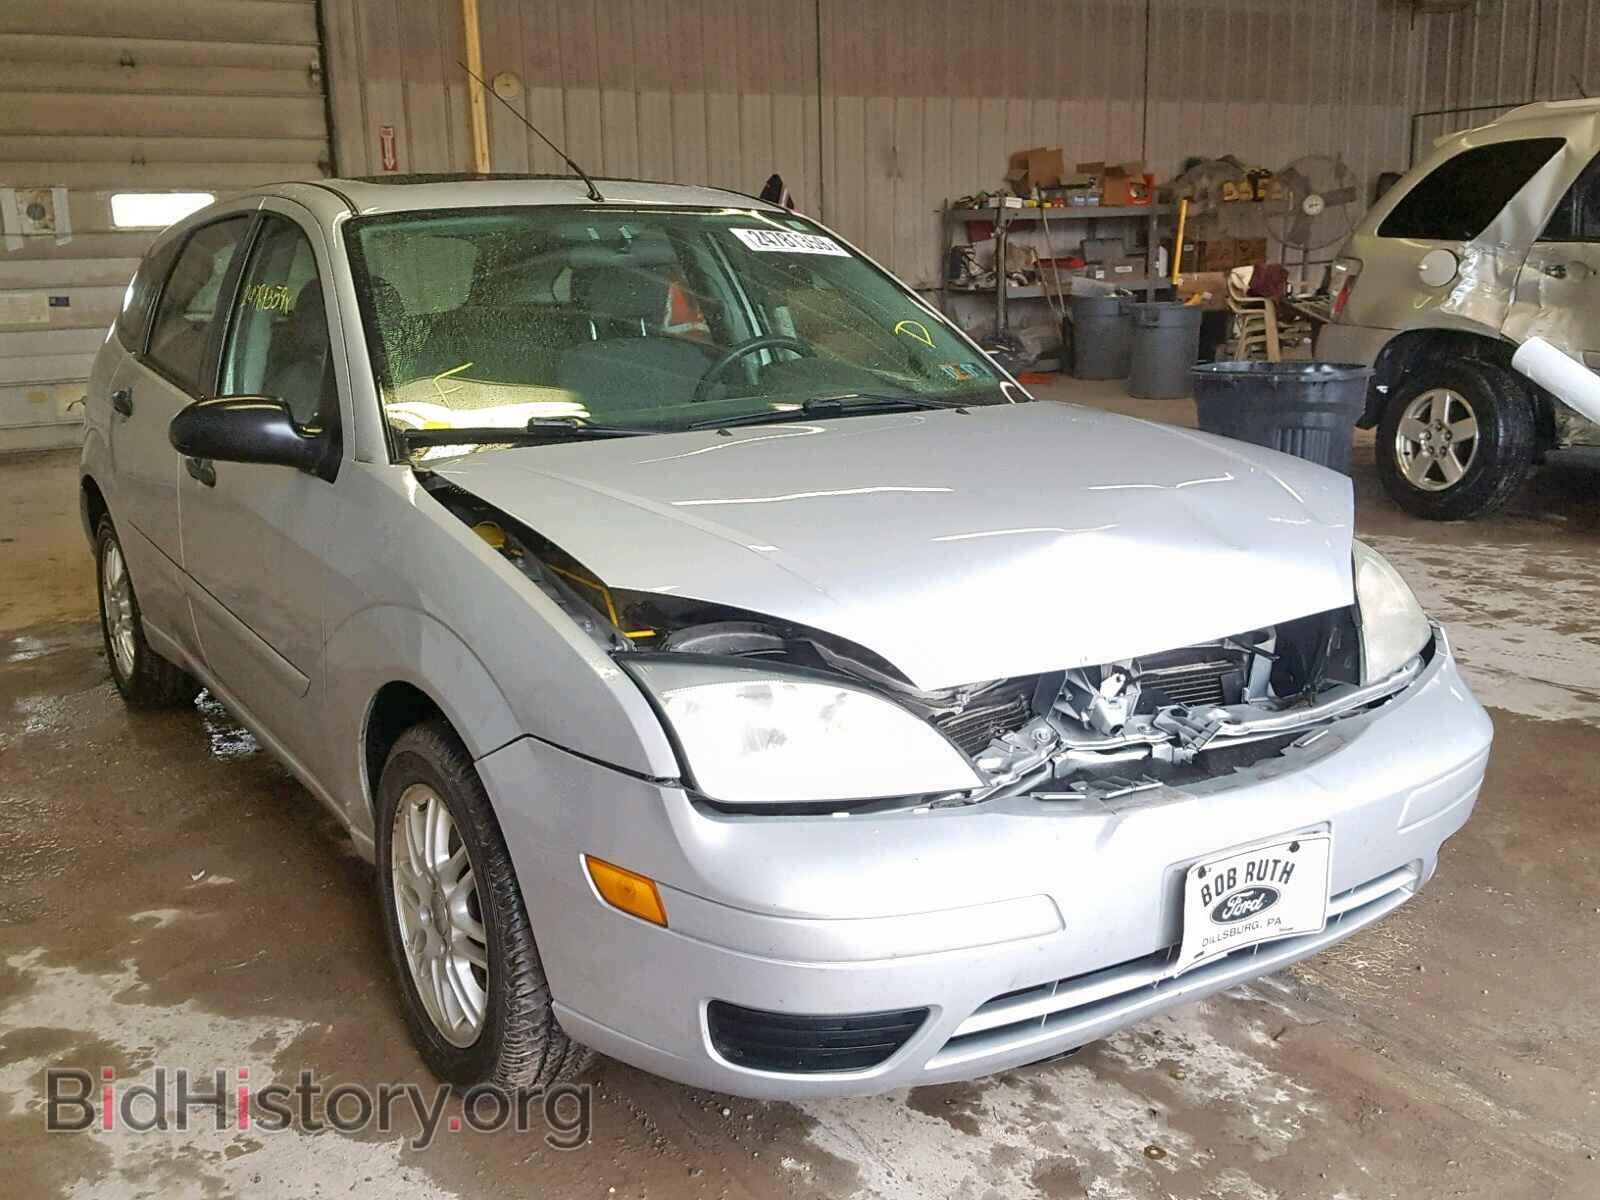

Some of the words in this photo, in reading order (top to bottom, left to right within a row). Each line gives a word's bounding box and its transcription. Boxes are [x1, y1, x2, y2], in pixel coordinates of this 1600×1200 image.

[1201, 867, 1237, 907] BOB
[1245, 859, 1295, 884] RUTH
[1222, 890, 1265, 919] Ford
[1267, 917, 1282, 926] PA
